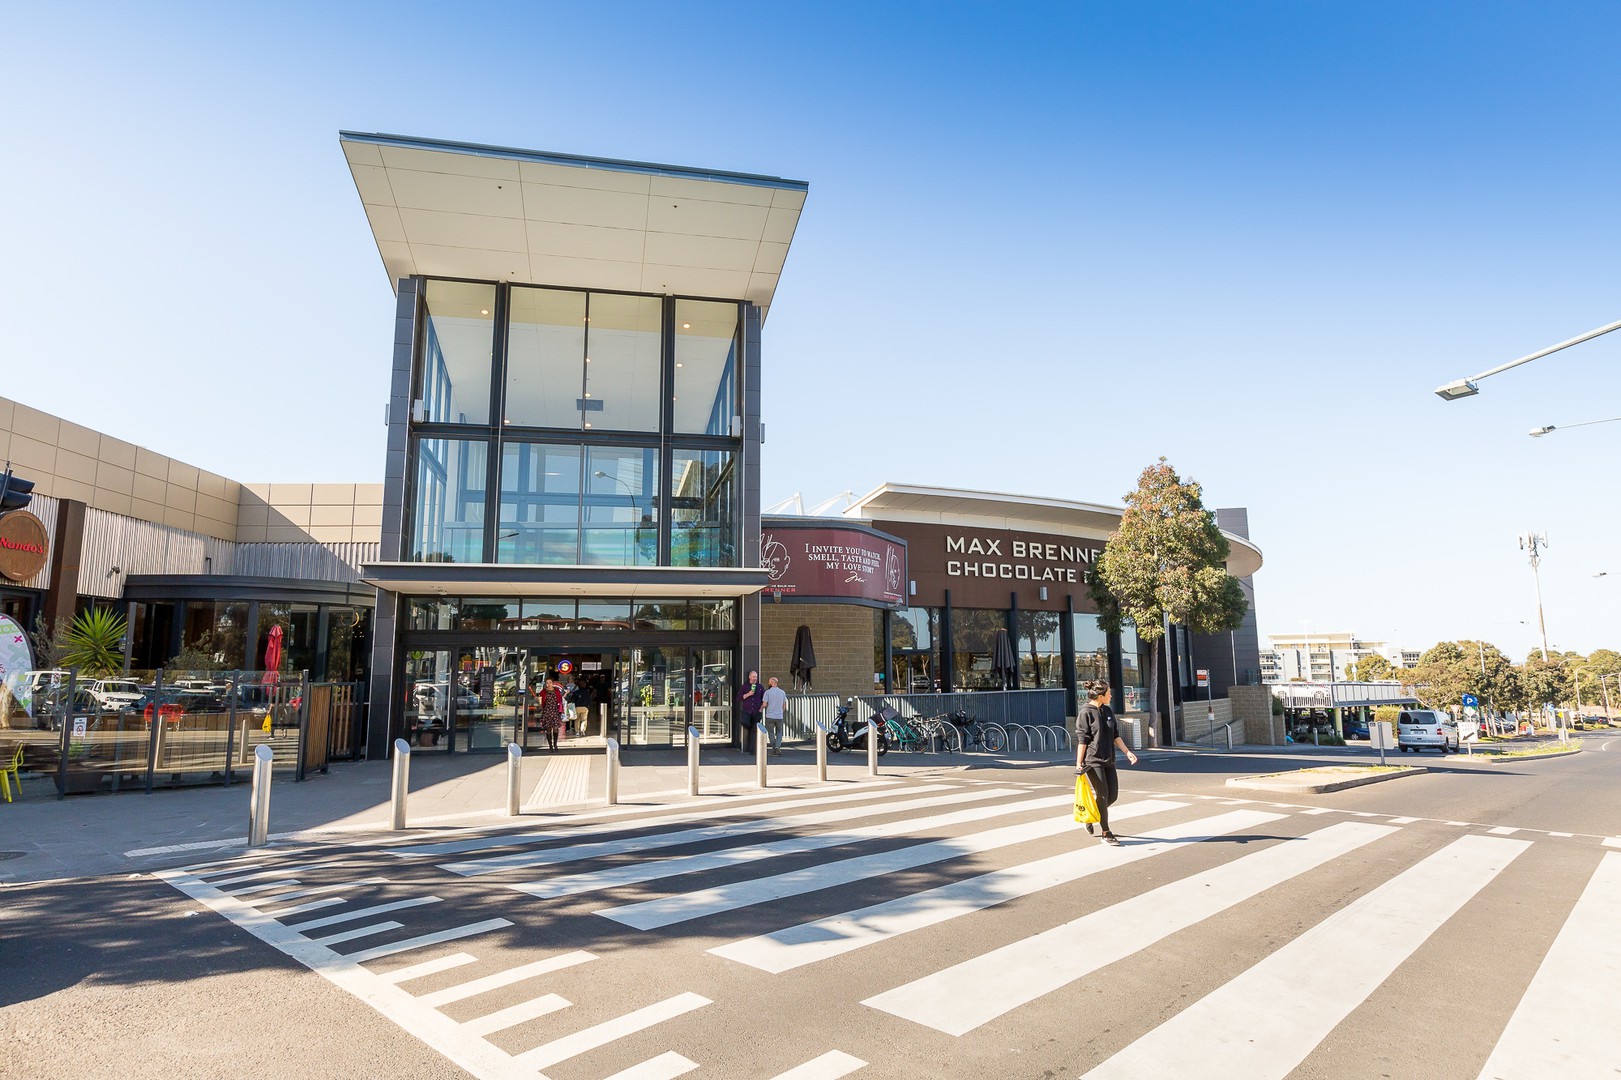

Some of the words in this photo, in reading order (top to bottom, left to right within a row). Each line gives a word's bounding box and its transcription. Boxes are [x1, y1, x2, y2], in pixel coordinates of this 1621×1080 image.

[0, 536, 44, 554] Nando's
[805, 543, 809, 553] I
[812, 545, 843, 554] INVITE
[845, 546, 860, 555] YOU
[946, 535, 1002, 556] MAX
[1012, 540, 1100, 564] BRENNE
[808, 553, 839, 562] SMELL,
[840, 554, 862, 563] TASTE
[826, 562, 840, 570] MY
[843, 562, 861, 571] LOVE
[947, 560, 1077, 583] CHOCOLATE
